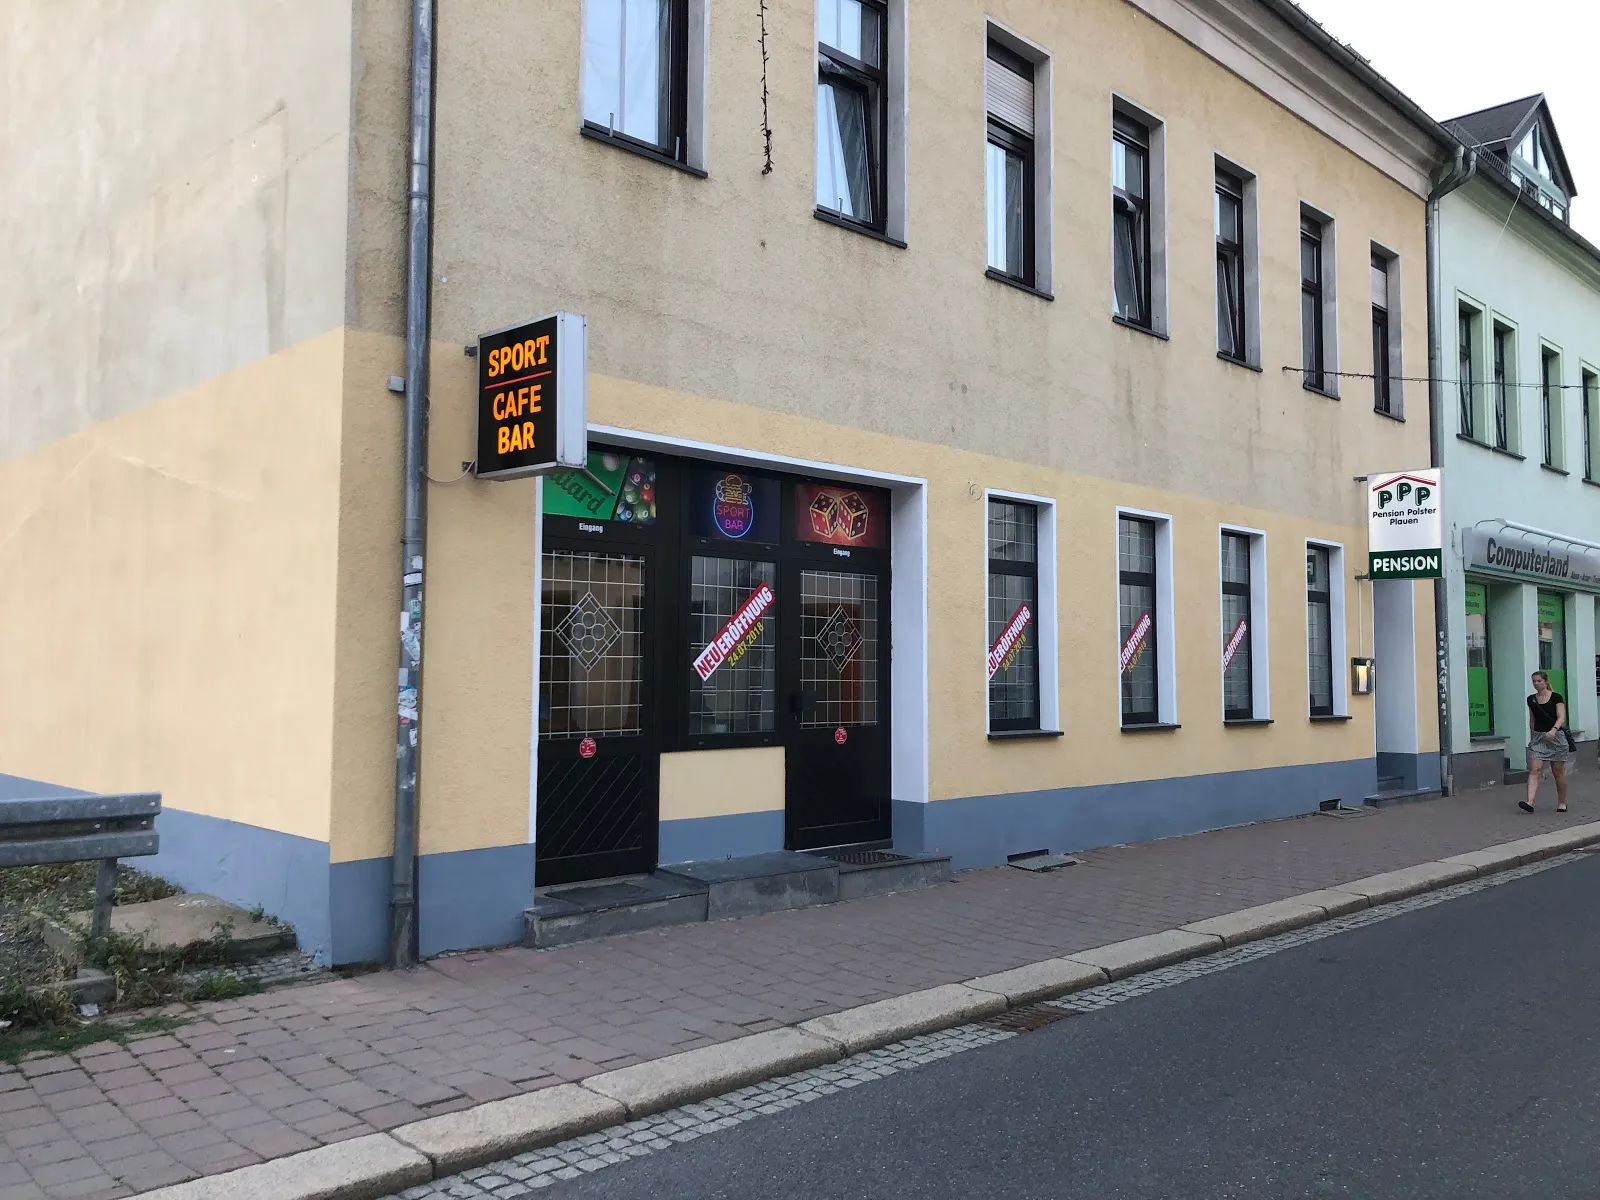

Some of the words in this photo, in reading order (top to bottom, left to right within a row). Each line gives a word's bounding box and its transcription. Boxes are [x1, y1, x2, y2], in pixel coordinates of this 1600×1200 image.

[488, 335, 550, 378] SPORT
[493, 384, 542, 421] CAFE
[498, 421, 536, 455] BAR
[716, 504, 750, 518] SPORT
[1372, 509, 1405, 518] Pension
[1407, 507, 1437, 516] Polster
[578, 522, 604, 533] Eingang
[725, 519, 744, 531] BAR
[1389, 517, 1419, 526] Plauen
[1373, 555, 1438, 572] PENSION
[1486, 536, 1569, 578] Computerland
[727, 622, 766, 668] 24.07.2018
